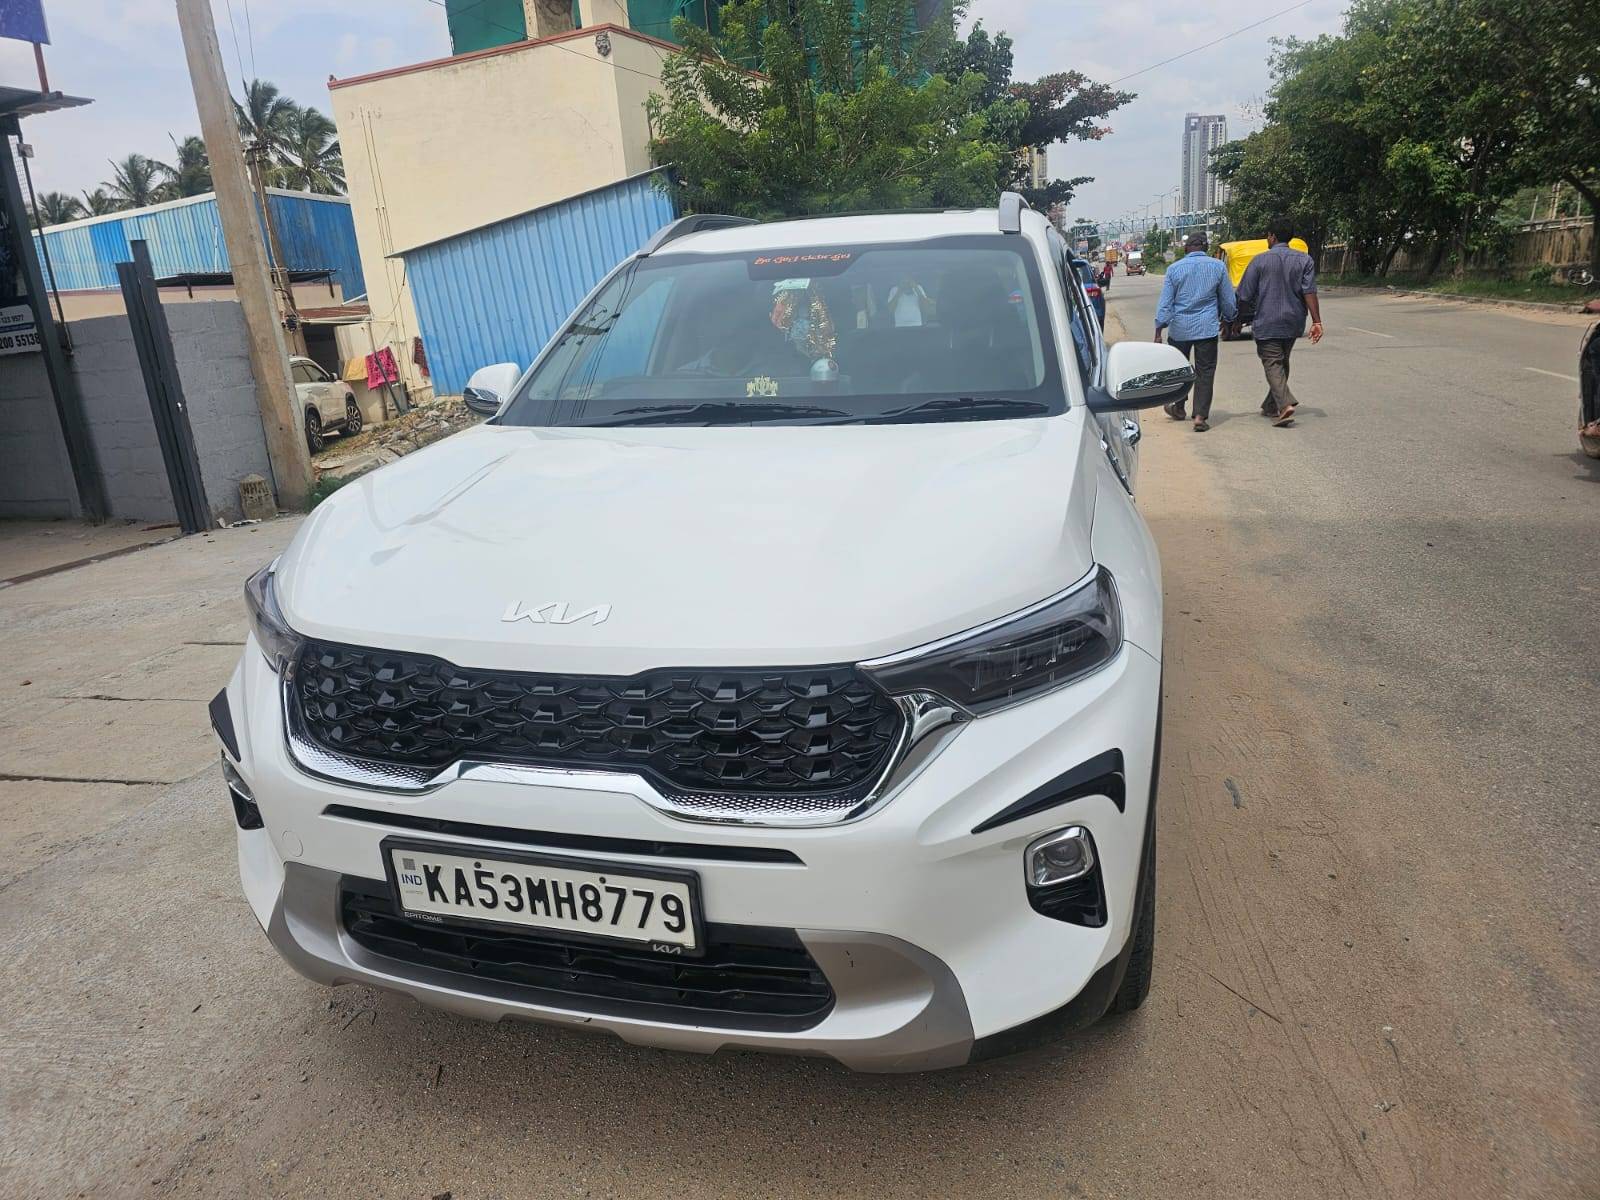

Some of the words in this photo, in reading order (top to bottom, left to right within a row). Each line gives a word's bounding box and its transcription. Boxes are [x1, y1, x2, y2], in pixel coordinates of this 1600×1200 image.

[15, 333, 40, 346] 55138
[501, 599, 612, 626] KIA
[401, 873, 422, 886] IND
[423, 864, 686, 933] KA53MH8779
[653, 943, 681, 955] KIA
